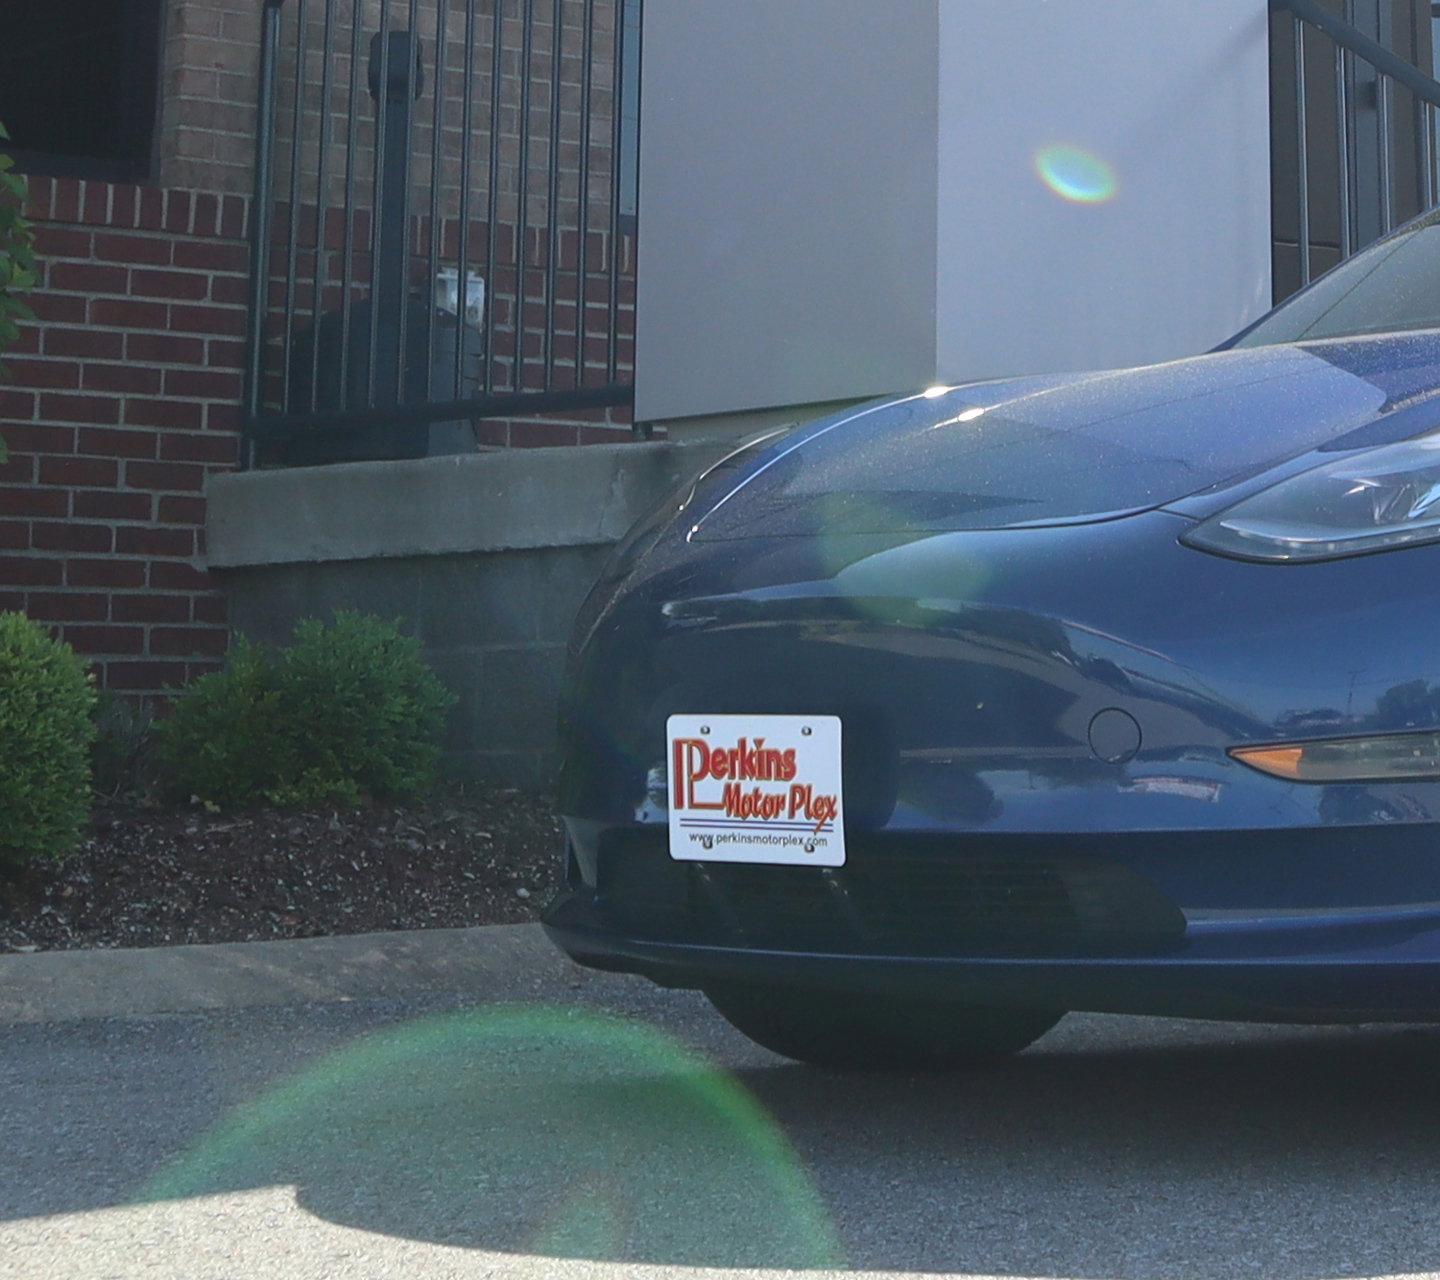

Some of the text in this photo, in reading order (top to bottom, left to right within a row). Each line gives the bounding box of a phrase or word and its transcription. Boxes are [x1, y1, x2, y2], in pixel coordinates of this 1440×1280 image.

[673, 737, 796, 809] Perkins
[723, 782, 837, 833] Motor Plex
